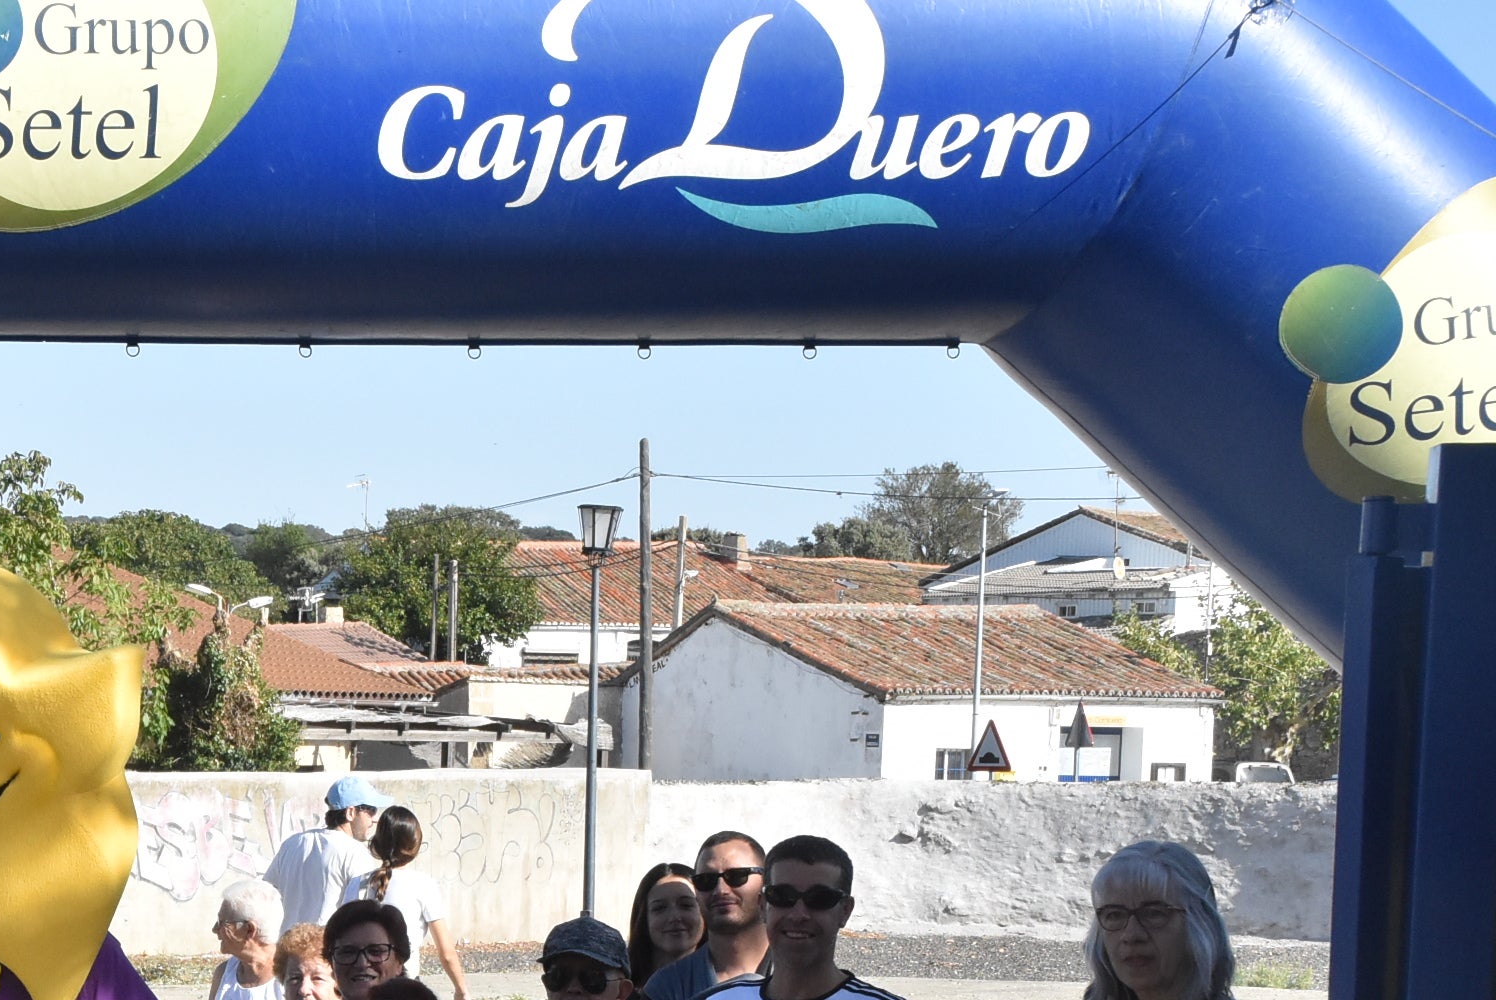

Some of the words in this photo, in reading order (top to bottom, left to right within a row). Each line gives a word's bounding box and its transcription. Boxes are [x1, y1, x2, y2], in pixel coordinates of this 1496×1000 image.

[34, 3, 209, 71] Grupo
[377, 83, 631, 208] Caja
[619, 0, 1090, 190] Duero
